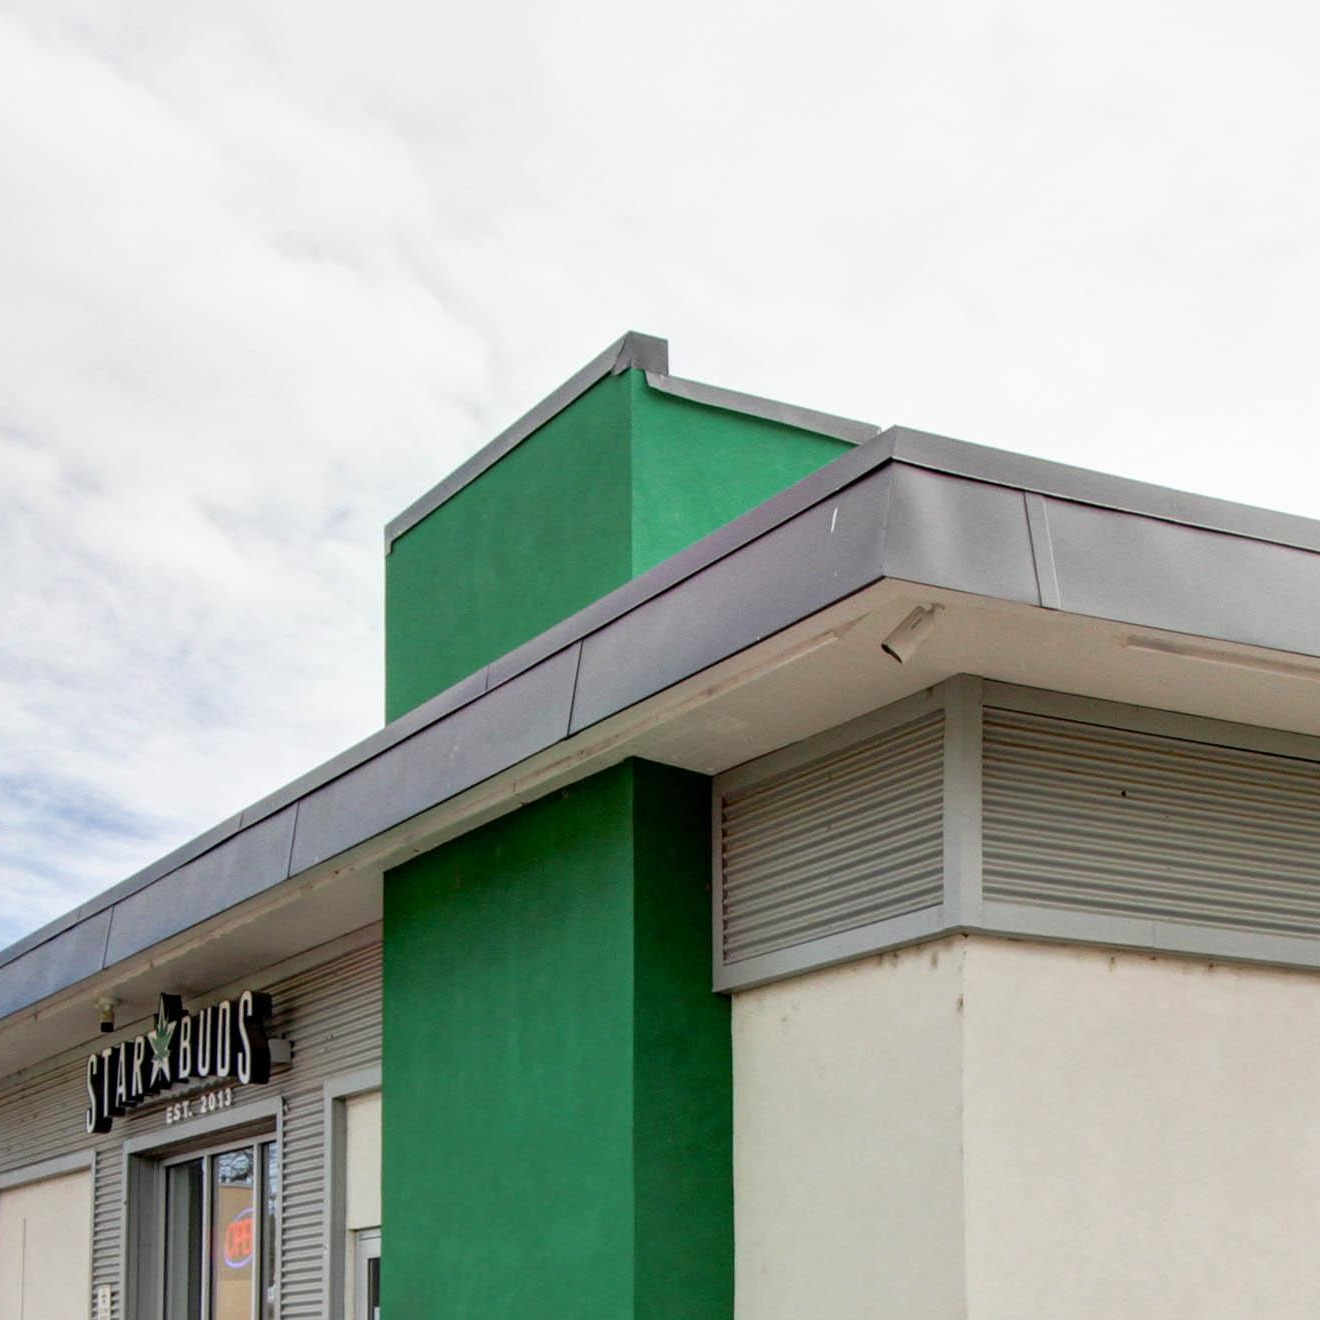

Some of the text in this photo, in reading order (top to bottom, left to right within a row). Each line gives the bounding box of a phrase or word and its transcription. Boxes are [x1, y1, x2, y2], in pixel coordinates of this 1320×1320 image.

[85, 990, 254, 1134] STAR BUDS
[166, 1087, 232, 1124] EST. 2013
[225, 1217, 255, 1259] OPE
